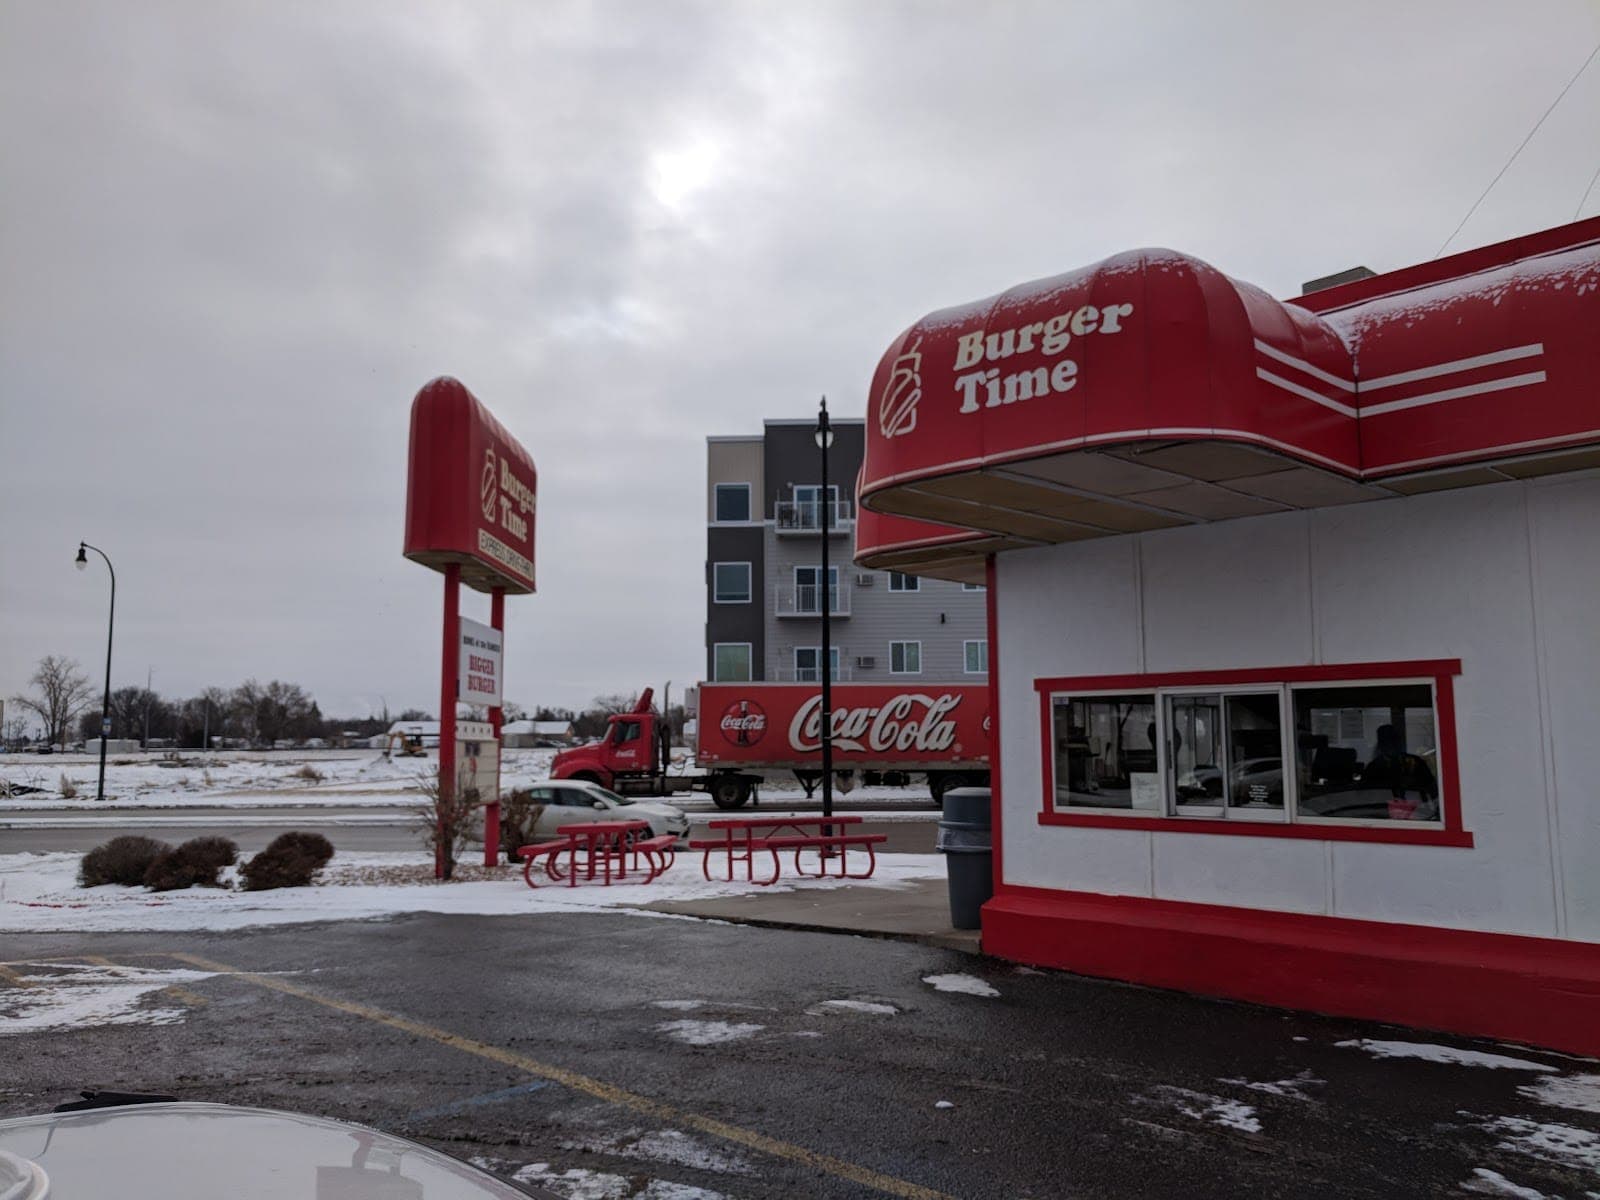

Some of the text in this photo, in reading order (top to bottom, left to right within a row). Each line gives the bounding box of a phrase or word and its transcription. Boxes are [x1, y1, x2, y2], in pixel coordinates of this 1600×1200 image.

[953, 303, 1134, 371] Burger
[954, 359, 1078, 414] Time
[500, 456, 536, 514] Burger
[500, 493, 528, 542] Time
[467, 673, 497, 694] BURGER
[788, 694, 962, 751] Coca-Cola
